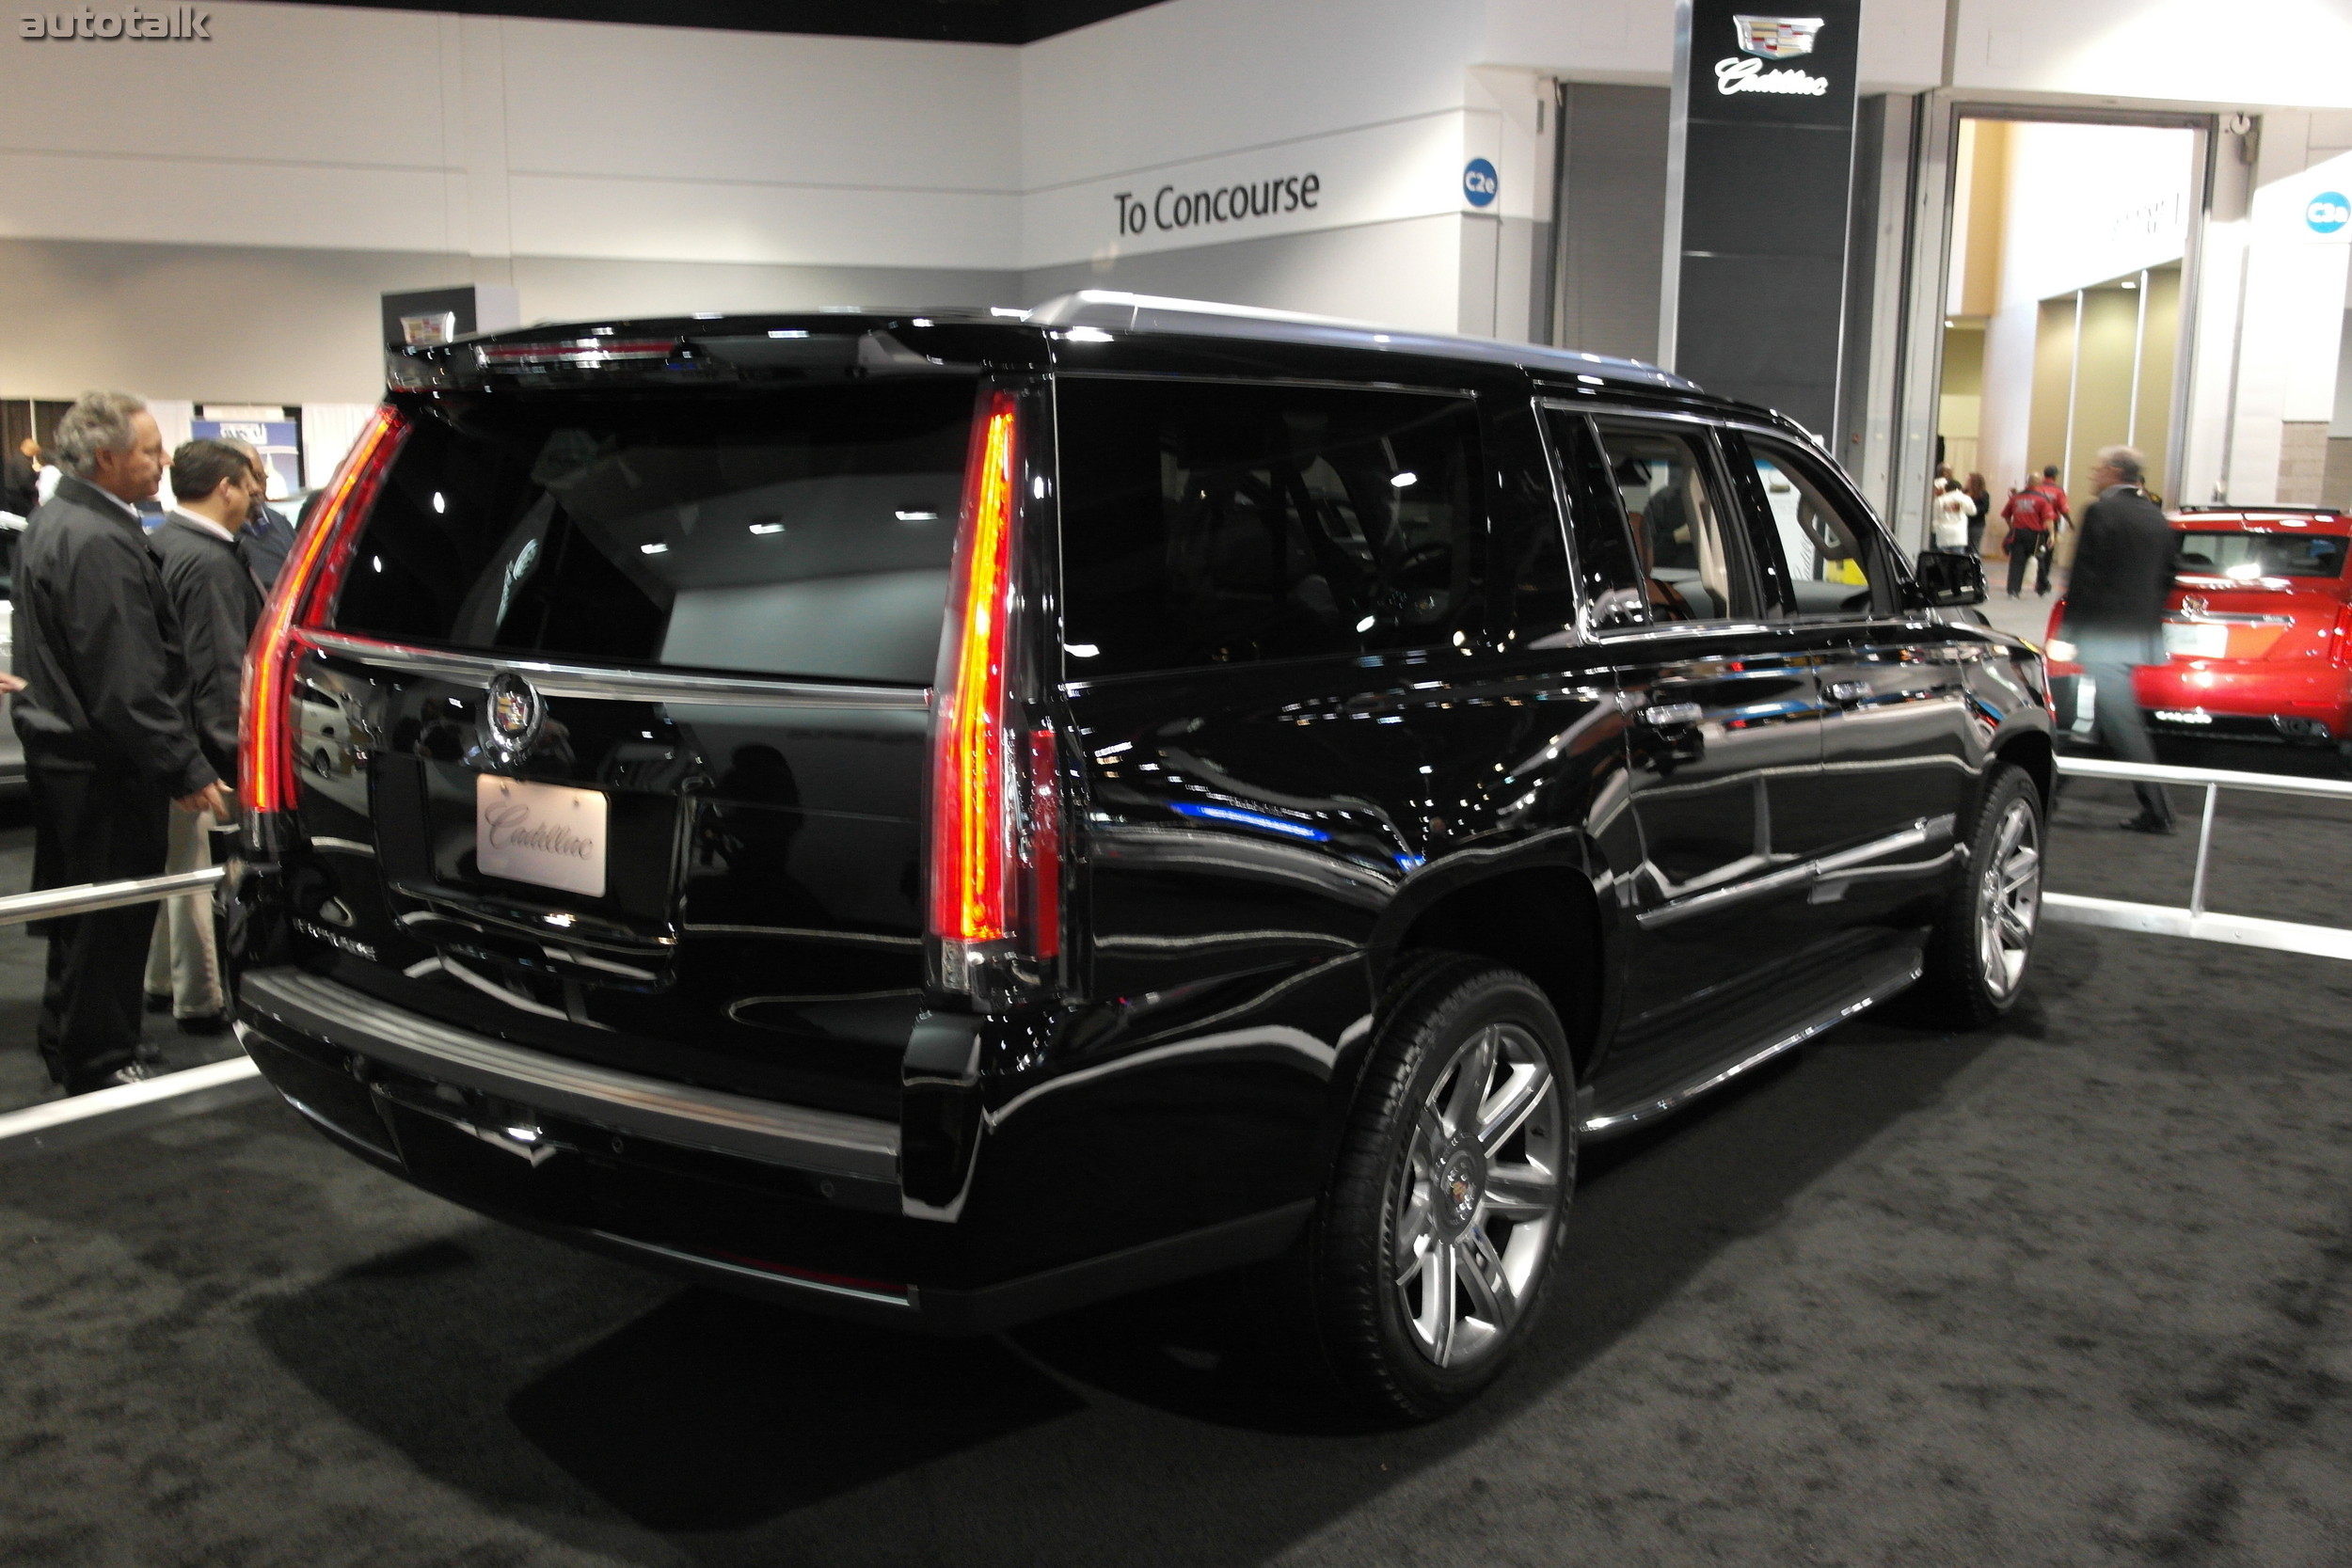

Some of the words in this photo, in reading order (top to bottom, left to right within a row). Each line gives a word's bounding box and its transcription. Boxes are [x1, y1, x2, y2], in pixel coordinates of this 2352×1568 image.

[1114, 192, 1147, 235] To
[1154, 172, 1320, 231] Concourse
[484, 800, 595, 861] Cadillac
